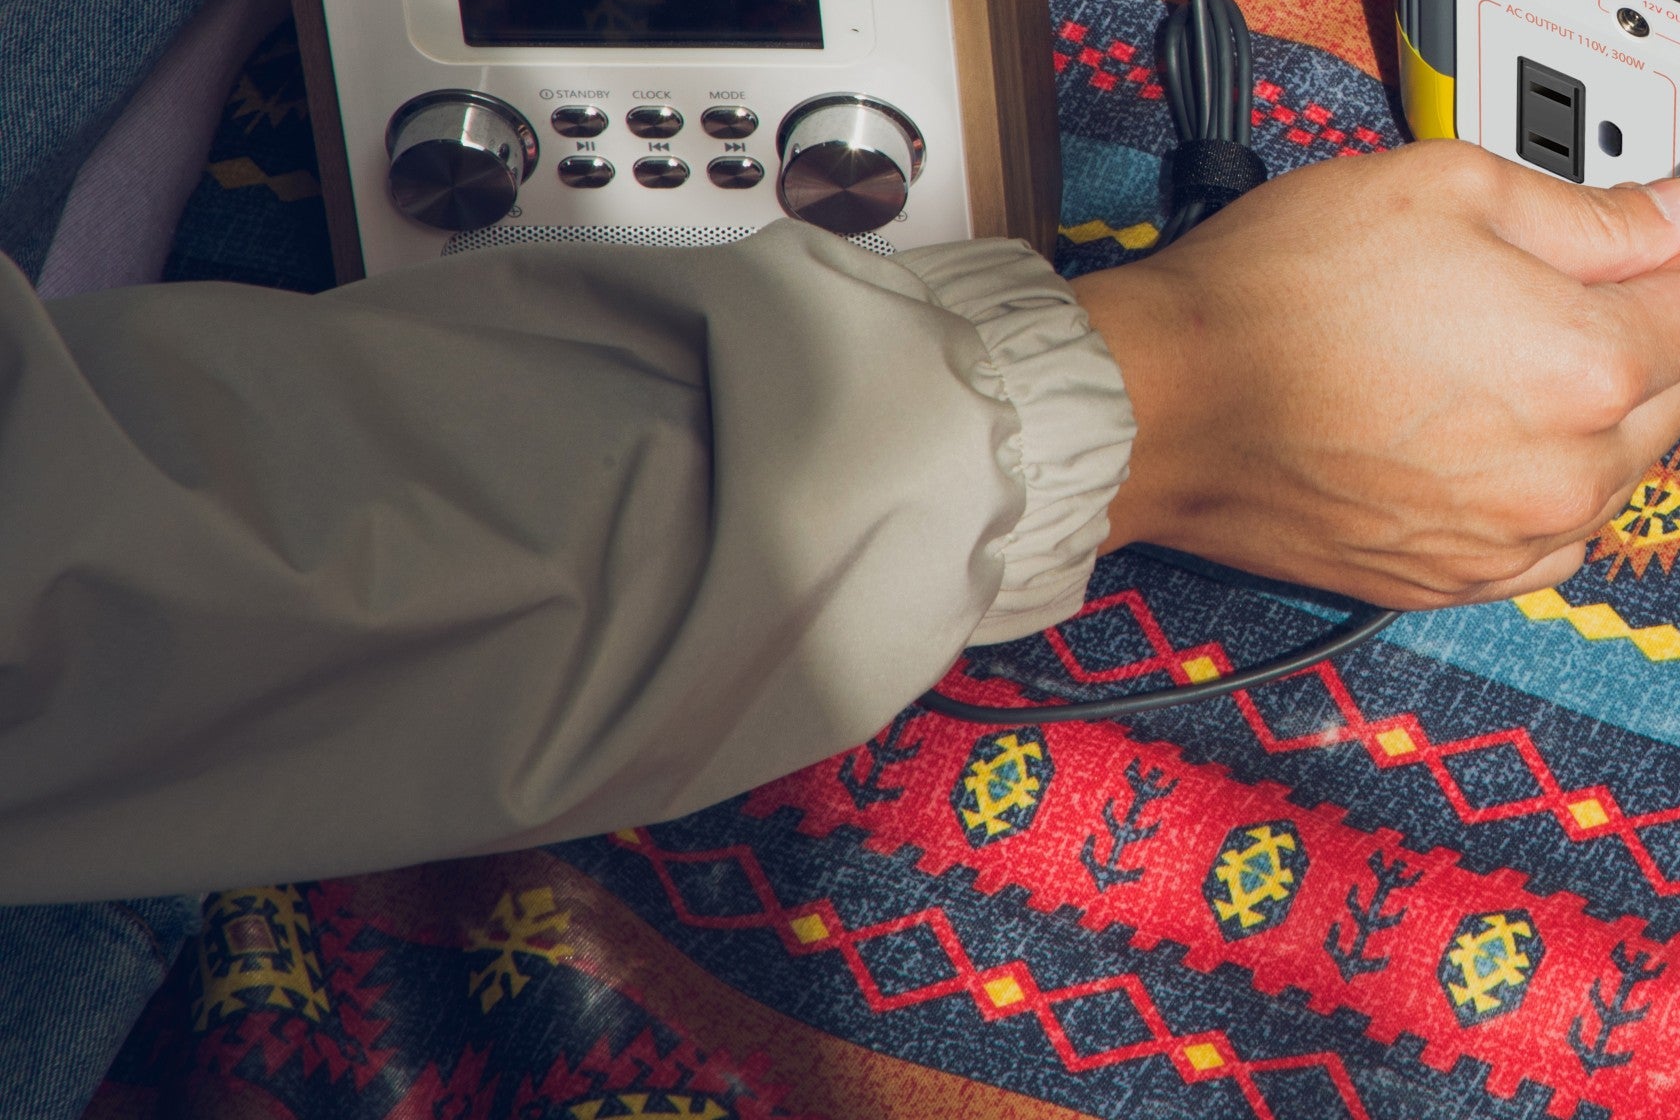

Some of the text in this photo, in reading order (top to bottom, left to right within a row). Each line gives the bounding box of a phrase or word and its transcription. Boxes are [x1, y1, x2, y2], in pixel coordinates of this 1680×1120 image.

[1643, 0, 1663, 14] 12V
[1506, 4, 1645, 71] AC OUTPUT 110V, 300W
[556, 89, 611, 99] STANDBY
[632, 90, 671, 99] CLOCK
[709, 91, 746, 100] MODE
